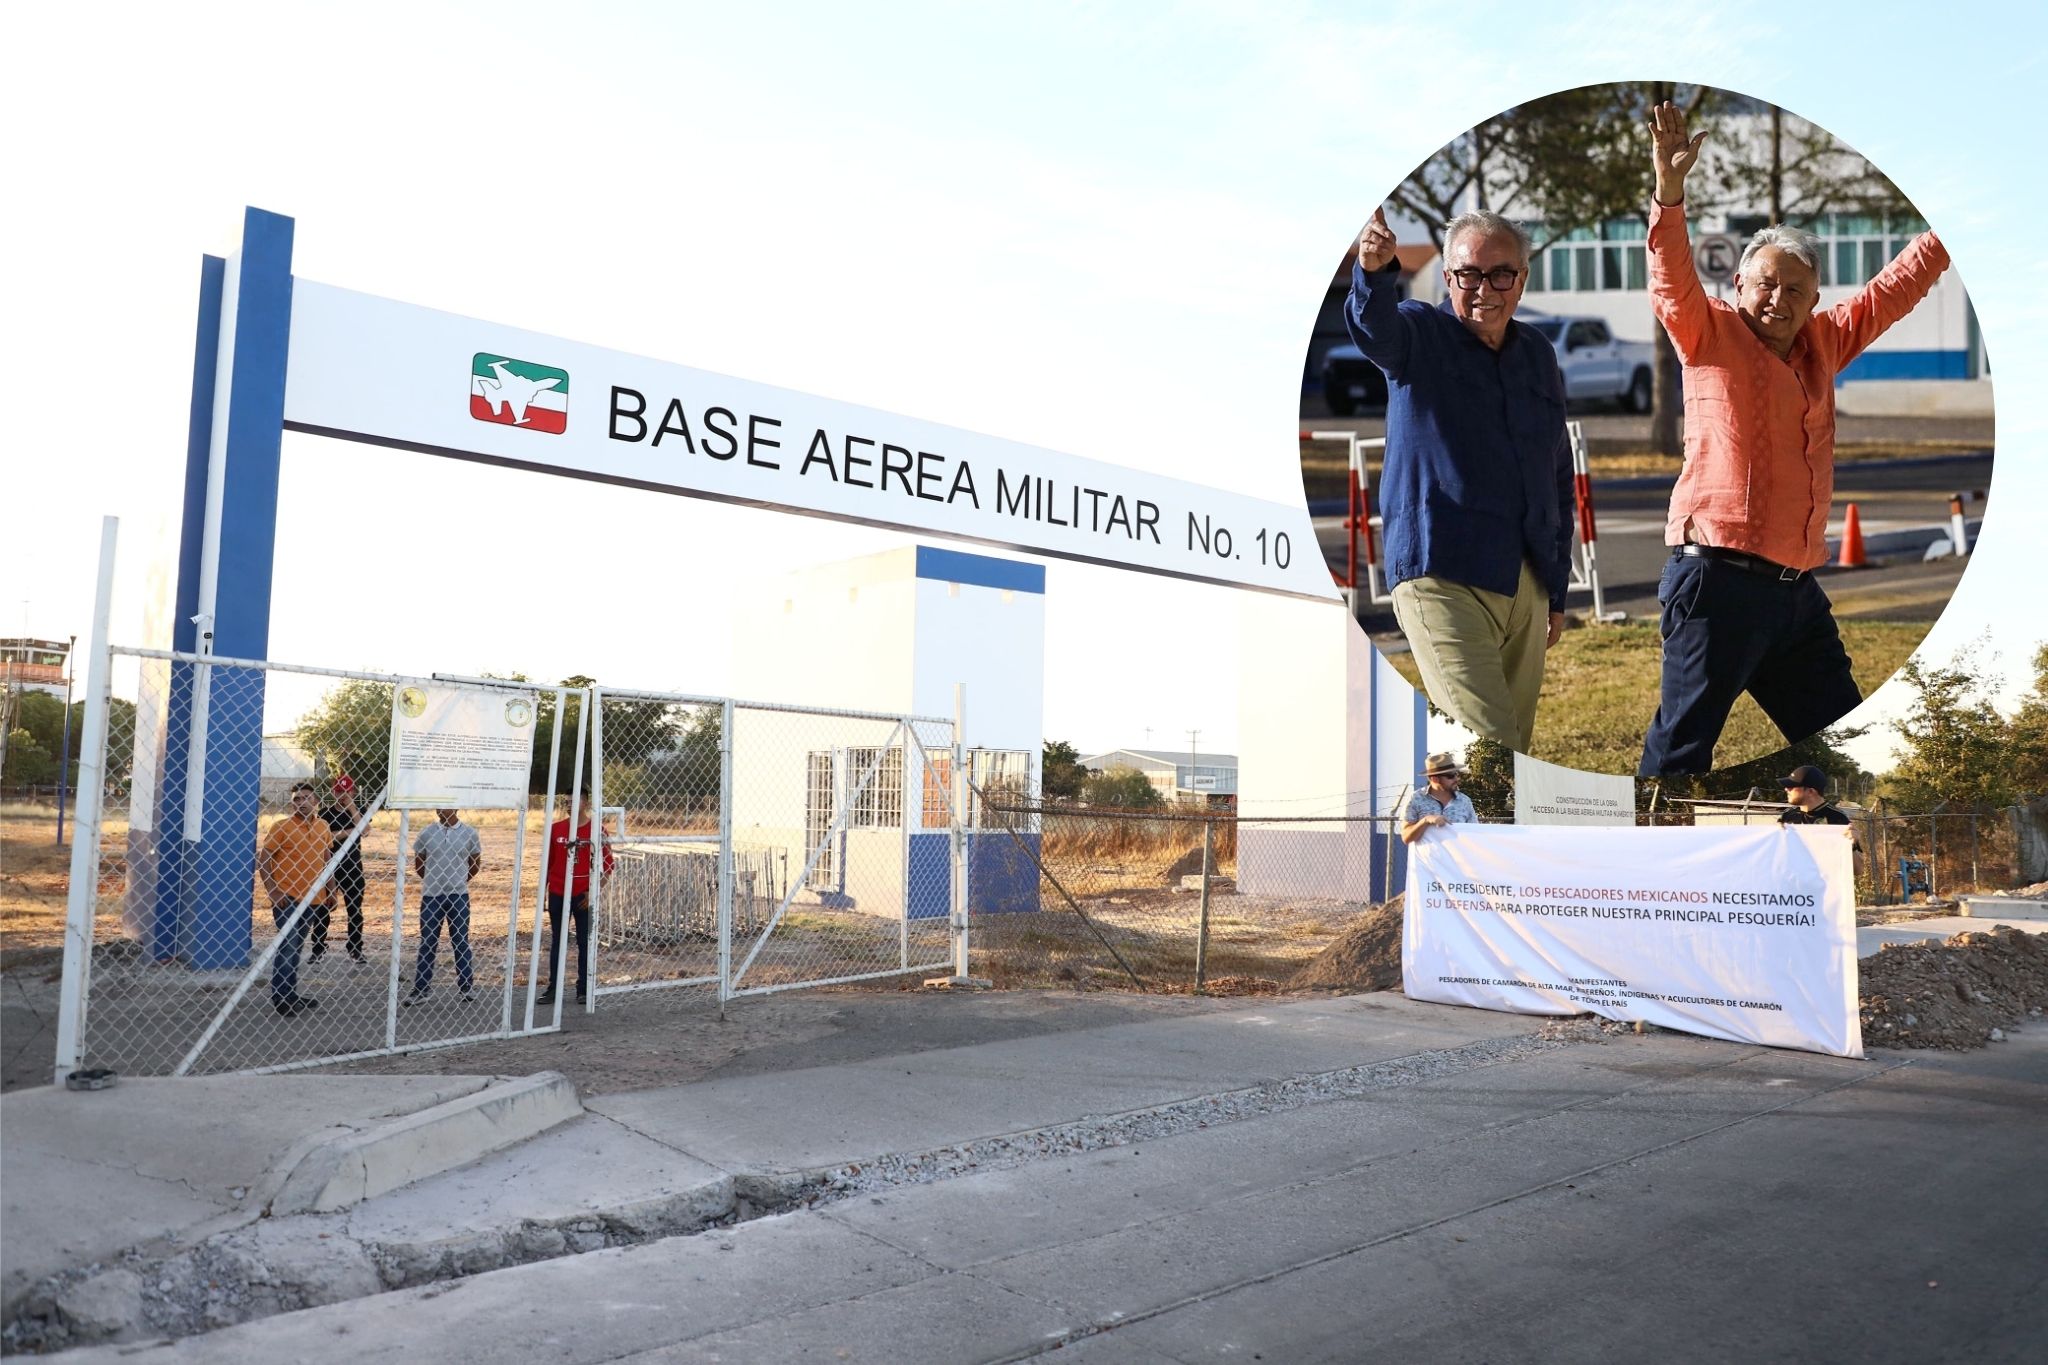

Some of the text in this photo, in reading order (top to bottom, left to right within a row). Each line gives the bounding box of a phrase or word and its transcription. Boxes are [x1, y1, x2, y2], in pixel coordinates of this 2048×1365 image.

[608, 384, 1292, 570] BASE AEREA MILITAR No. 10
[1561, 807, 1567, 815] LA
[1568, 807, 1580, 816] BASE
[1593, 798, 1600, 806] DE
[1600, 799, 1606, 807] LA
[1606, 799, 1618, 807] OBRA
[1448, 883, 1516, 898] PRESIDENTE,
[1519, 886, 1541, 898] LOS
[1544, 887, 1624, 901] PESCADORES
[1627, 889, 1709, 904] MEXICANOS
[1712, 892, 1815, 907] NECESITAMOS
[1426, 897, 1816, 927] SU DEFENSA PARA PROTEGER NUESTRA PRINCIPAL PESQUERÍA!
[1438, 976, 1481, 985] PESCADORES
[1481, 978, 1491, 986] DE
[1528, 981, 1537, 989] DE
[1555, 984, 1575, 993] MAR,
[1667, 995, 1725, 1007] ACUICULTORES
[1726, 999, 1738, 1008] DE
[1739, 1000, 1783, 1012] CAMARÓN
[1570, 994, 1580, 1002] DE
[1612, 999, 1628, 1008] PAÍS
